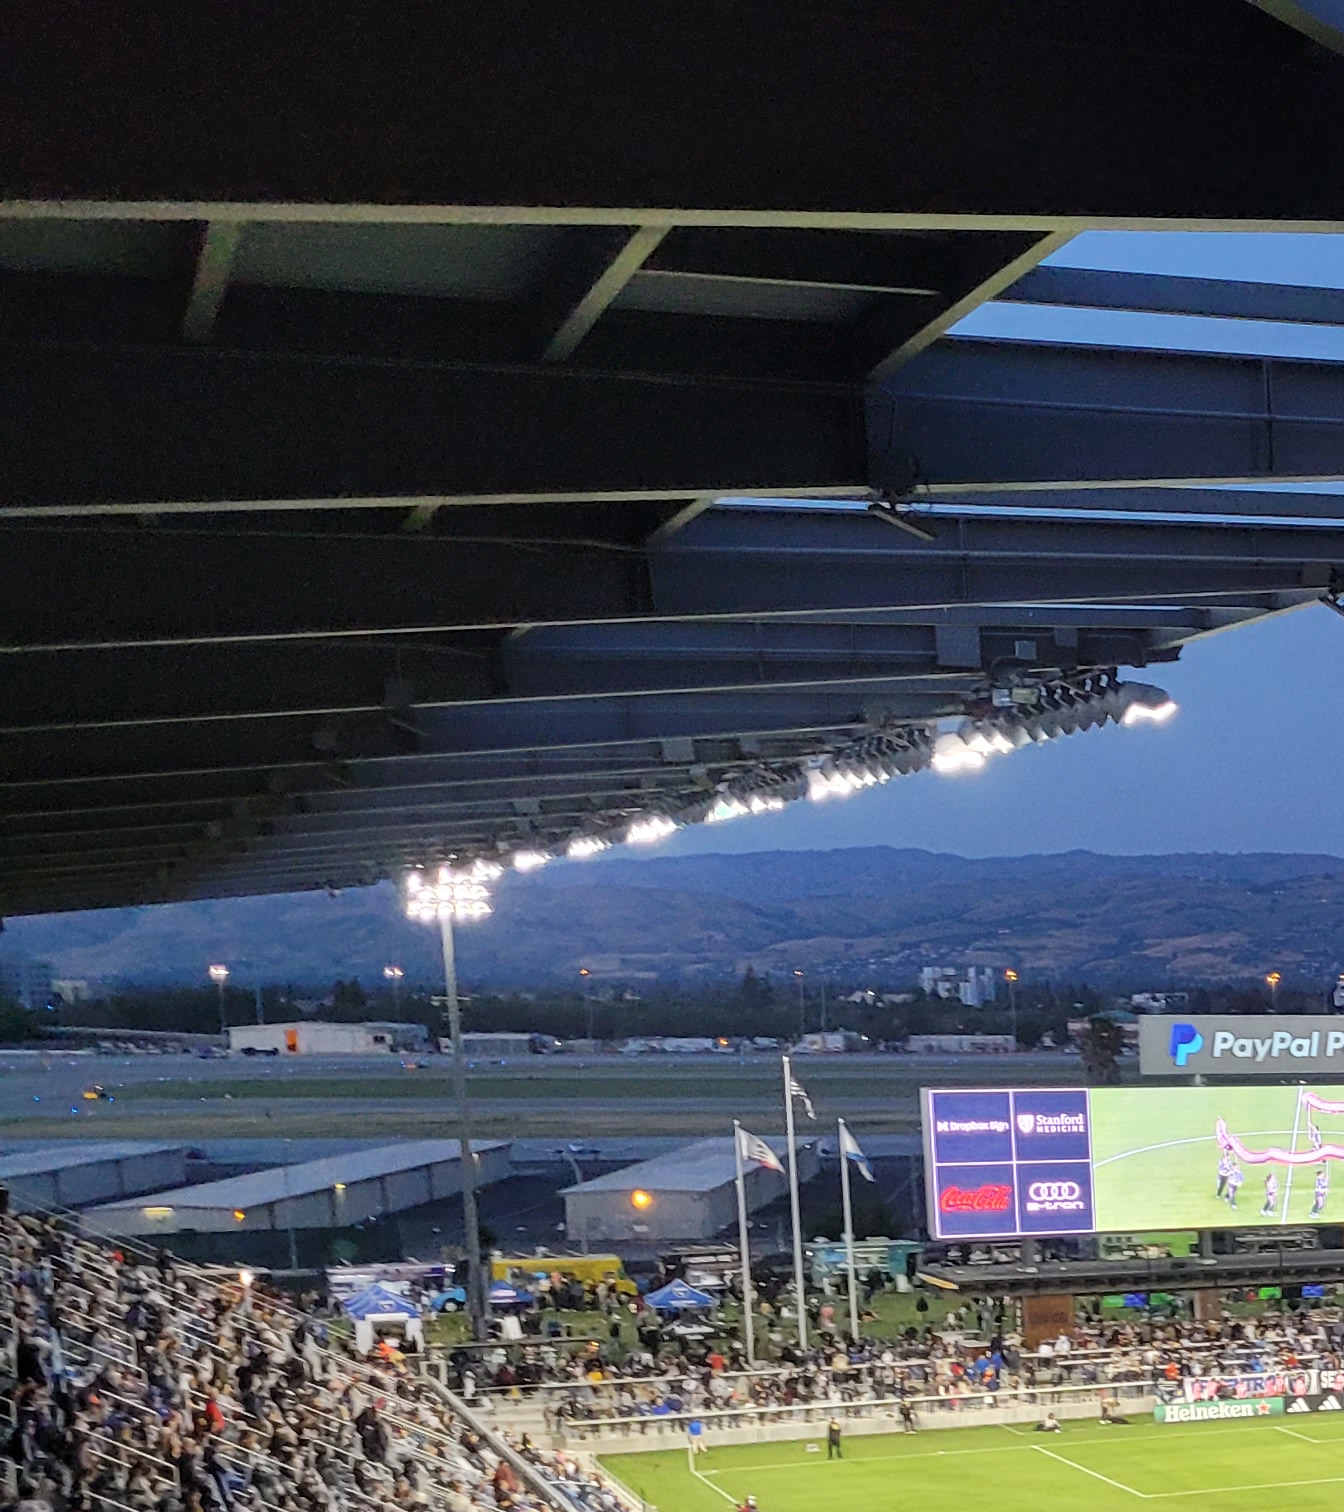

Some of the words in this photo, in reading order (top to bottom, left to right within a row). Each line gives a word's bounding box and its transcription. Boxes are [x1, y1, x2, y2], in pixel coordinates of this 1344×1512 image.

[1213, 1030, 1319, 1062] PayPal
[1036, 1113, 1084, 1125] Stanford
[950, 1121, 989, 1133] Dropbox
[989, 1121, 1010, 1133] Sign
[1036, 1125, 1086, 1133] MEDICINE
[1027, 1201, 1085, 1211] e-tron
[1164, 1402, 1254, 1423] Heineken
